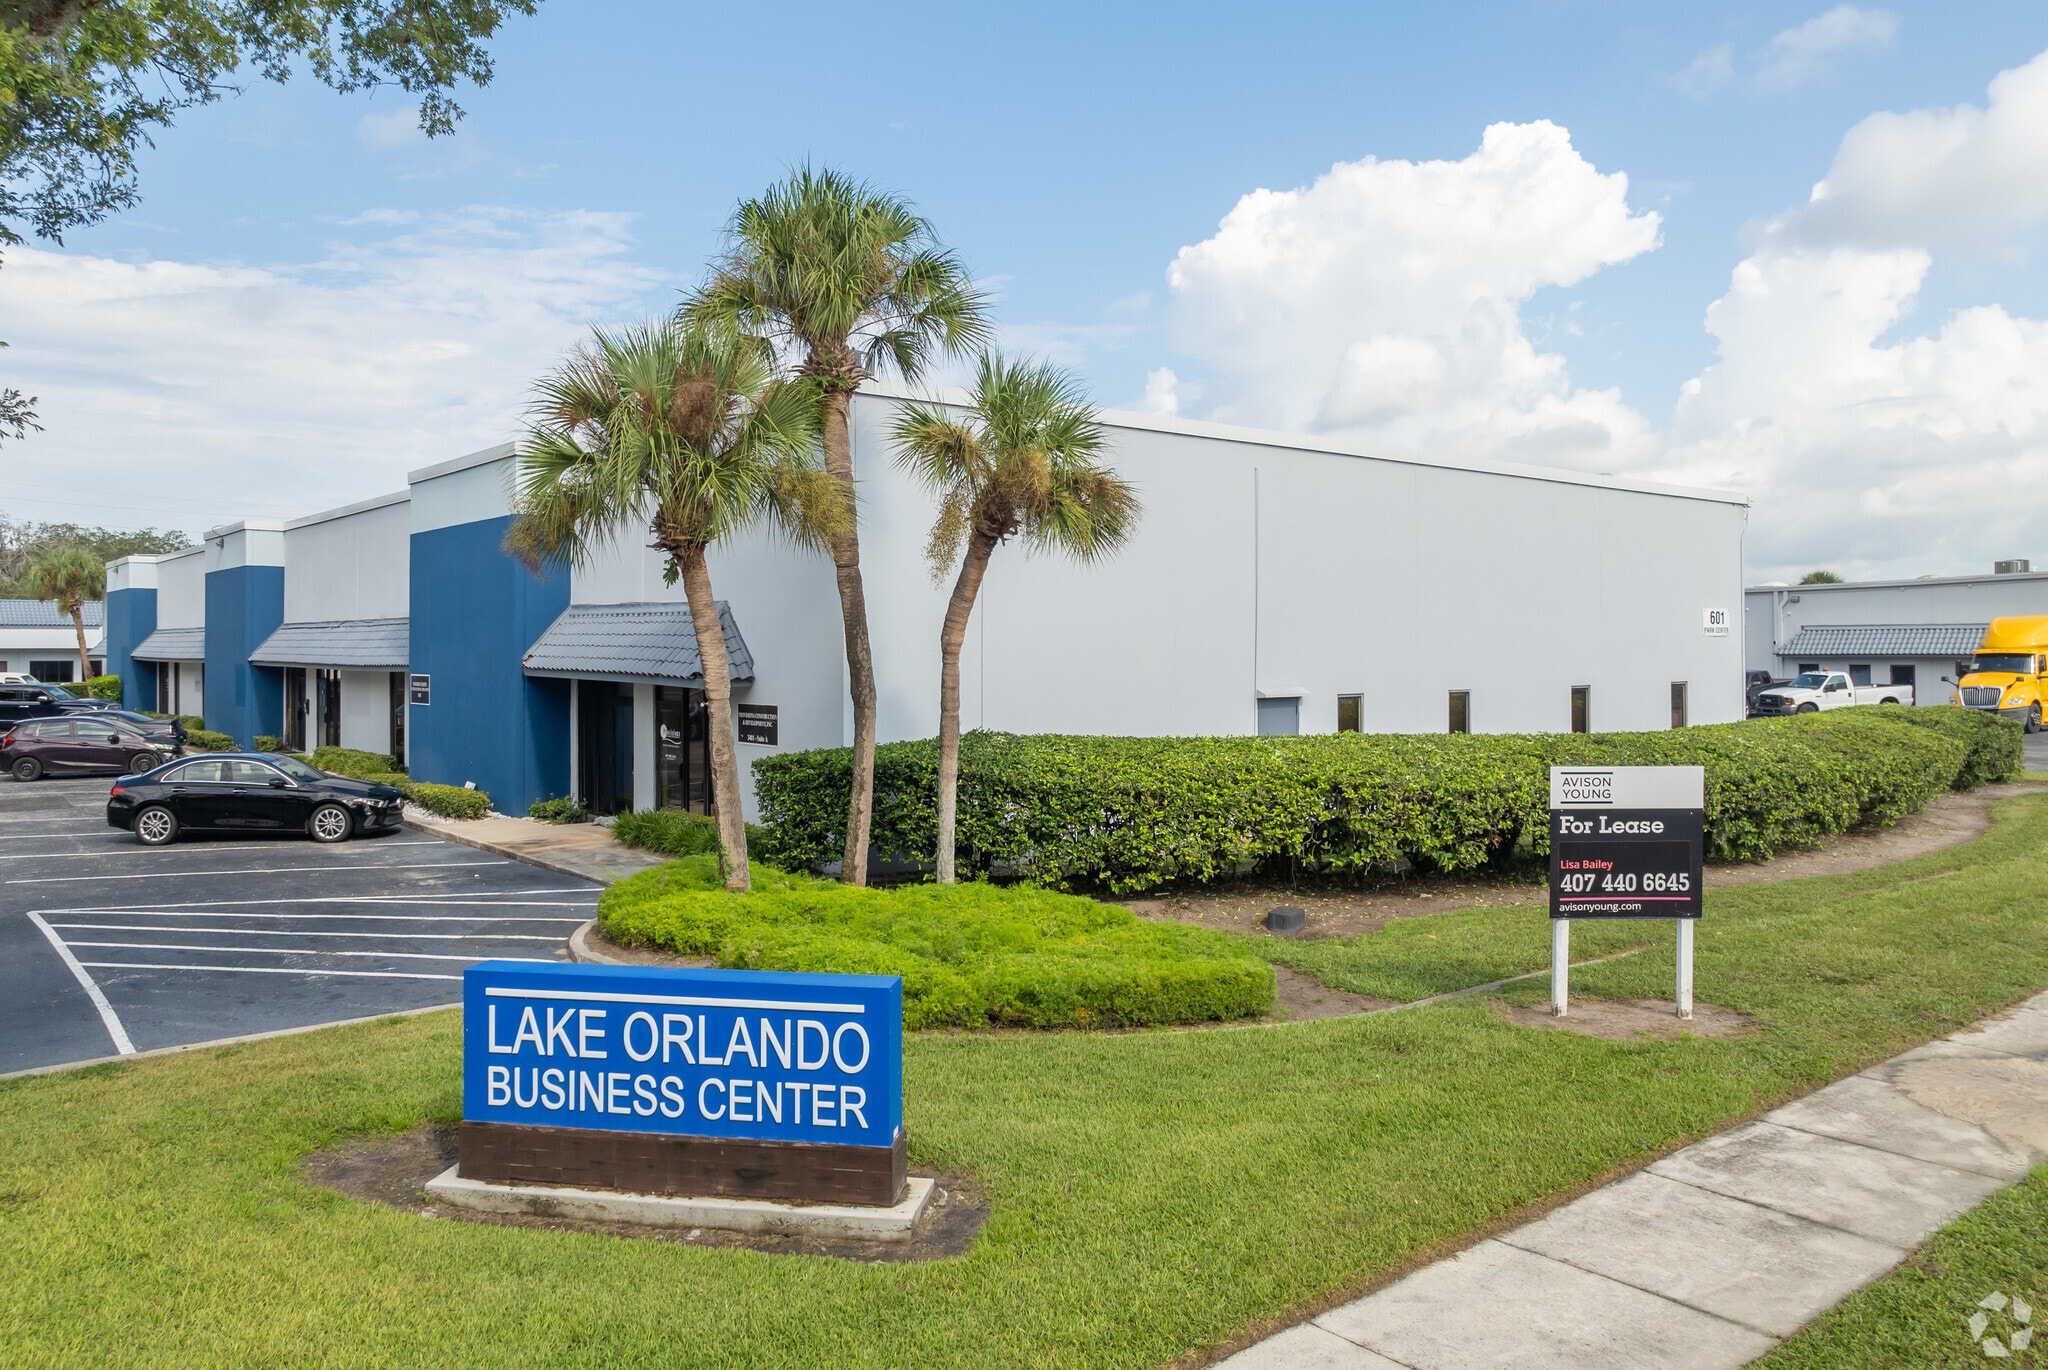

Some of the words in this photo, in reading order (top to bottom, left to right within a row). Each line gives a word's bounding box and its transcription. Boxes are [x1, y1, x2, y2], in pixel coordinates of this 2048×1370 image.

[1710, 611, 1725, 625] 601
[1562, 777, 1611, 787] AVISON
[1562, 789, 1611, 799] YOUNG
[1559, 815, 1594, 834] For
[1599, 815, 1665, 834] Lease
[1560, 860, 1580, 869] Lisa
[1582, 860, 1613, 871] Bailey
[1560, 873, 1596, 892] 407
[1601, 873, 1637, 892] 440
[1643, 873, 1690, 892] 6645
[1559, 902, 1642, 912] avisonyoung.com
[487, 1004, 608, 1059] LAKE
[623, 1011, 871, 1074] ORLANDO
[487, 1065, 685, 1119] BUSINESS
[699, 1078, 869, 1129] CENTER
